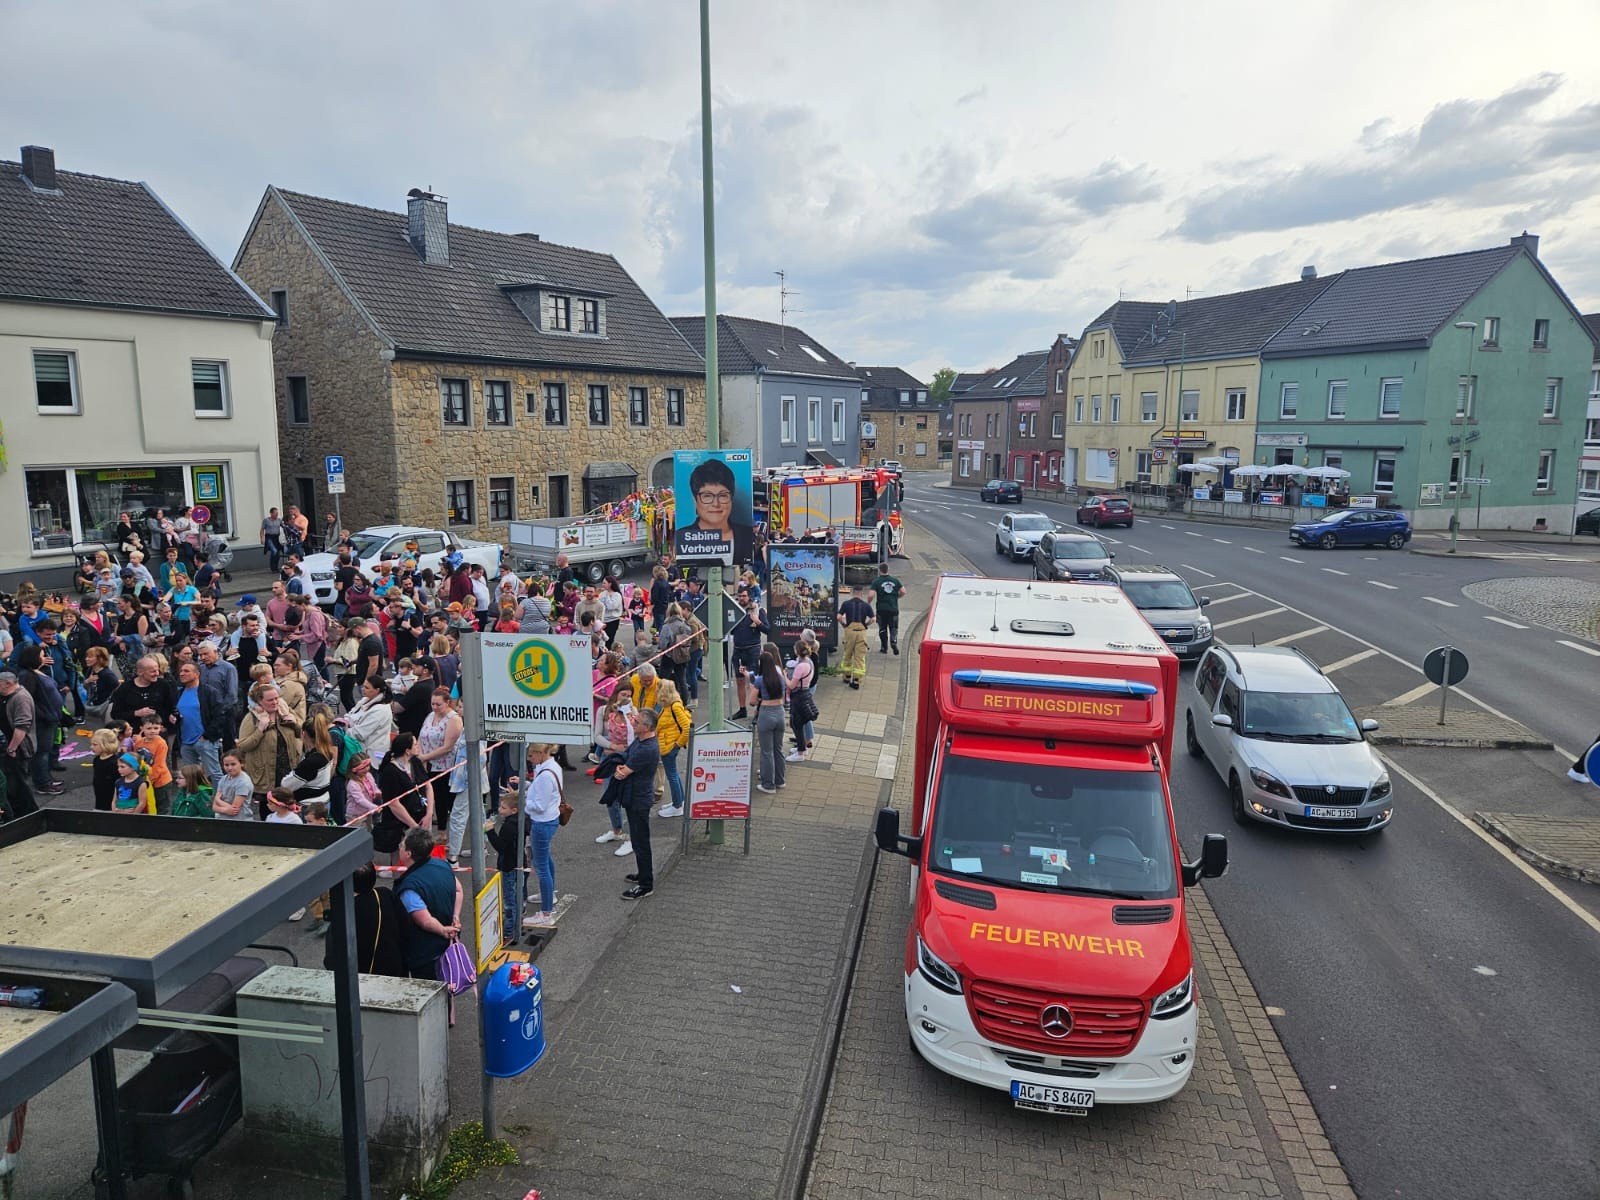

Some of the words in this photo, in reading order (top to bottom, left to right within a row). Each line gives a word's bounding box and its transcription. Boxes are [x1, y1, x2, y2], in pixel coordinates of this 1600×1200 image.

[330, 458, 340, 472] P
[684, 531, 720, 541] Sabine
[680, 543, 729, 554] Verheyen
[523, 653, 551, 684] H
[487, 703, 547, 721] MAUSBACH
[550, 706, 589, 722] KIRCHE
[983, 693, 1123, 717] RETTUNGSDIENST
[698, 749, 749, 757] Familienfest
[969, 921, 1146, 959] FEUERWEHR
[1020, 1085, 1035, 1099] AC
[1044, 1088, 1060, 1103] FS
[1062, 1091, 1092, 1106] 8407
